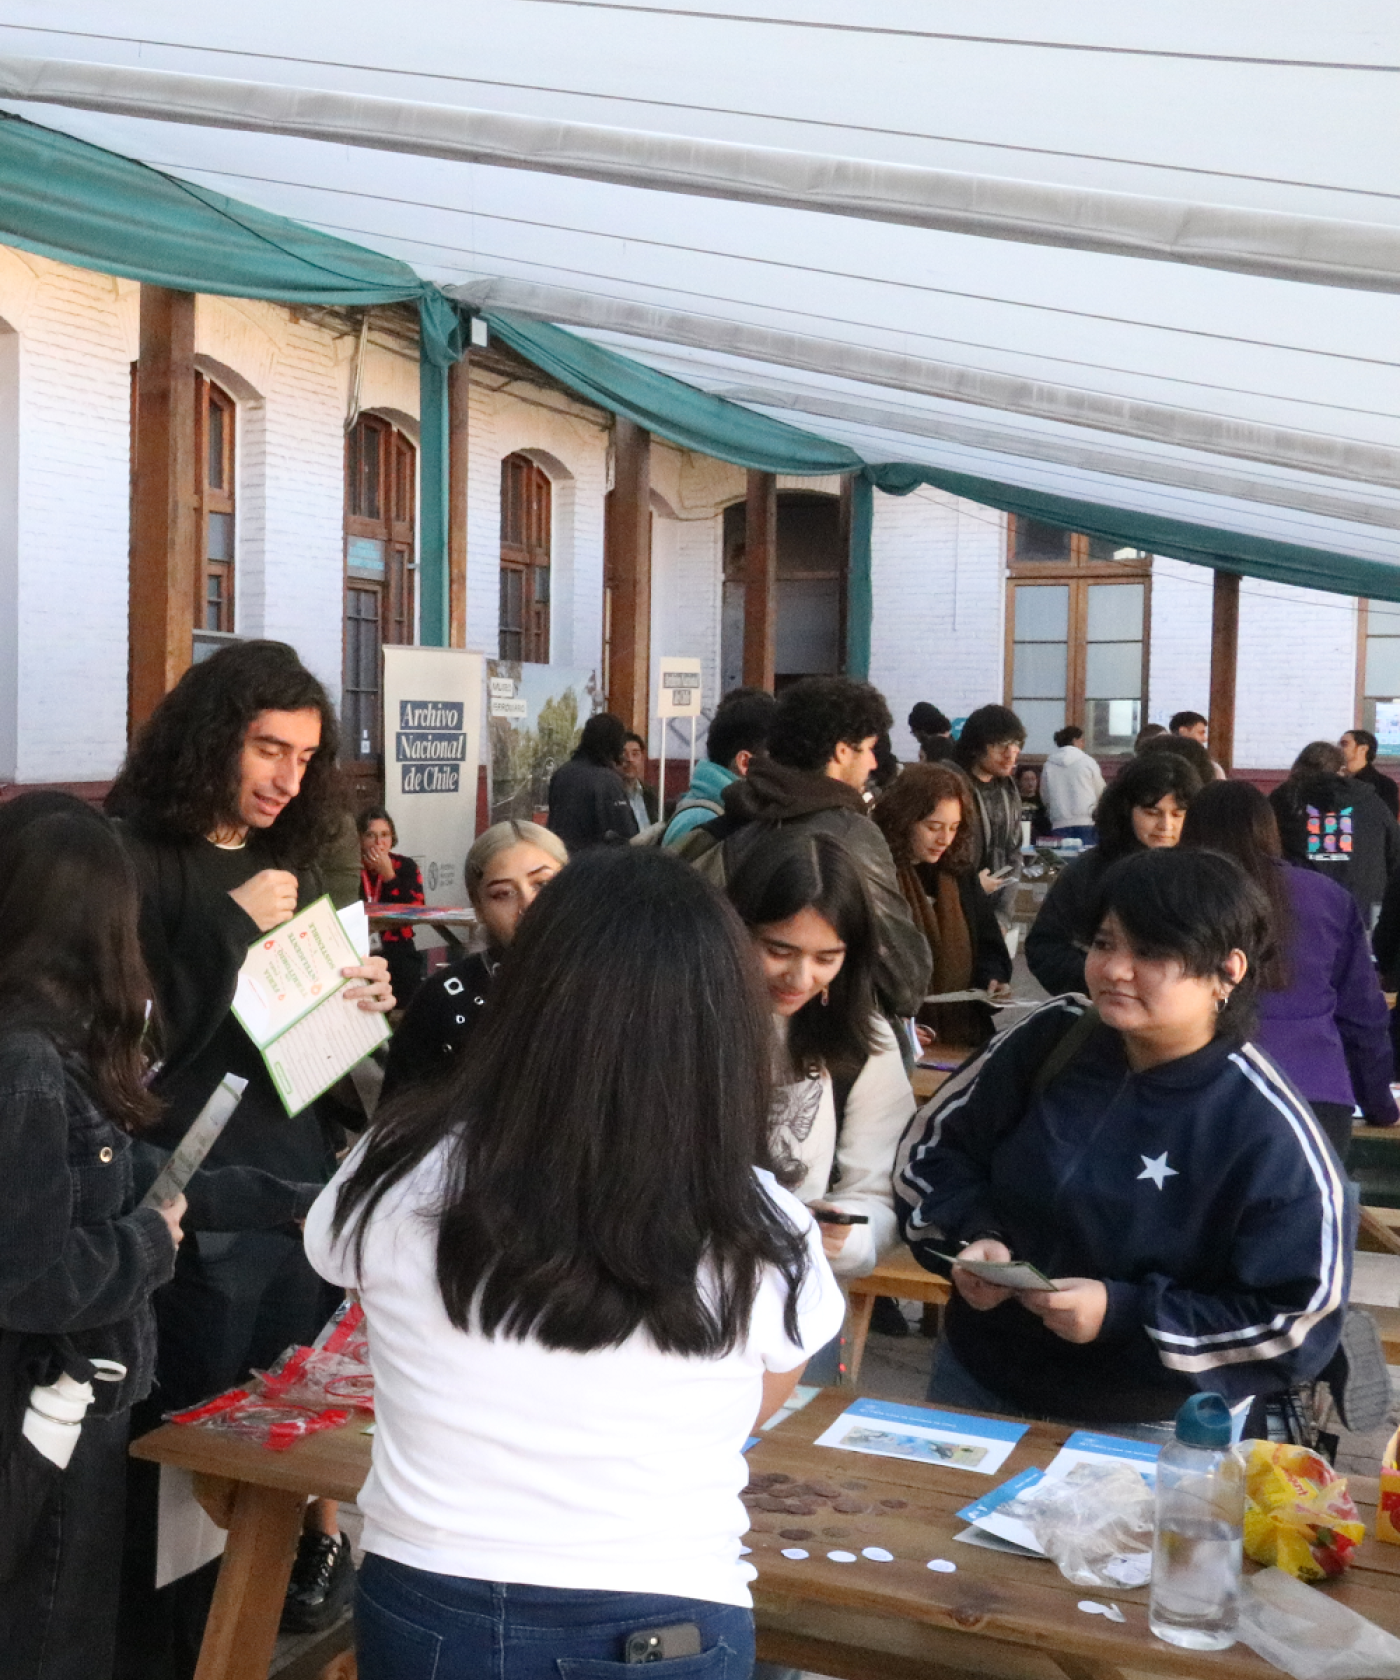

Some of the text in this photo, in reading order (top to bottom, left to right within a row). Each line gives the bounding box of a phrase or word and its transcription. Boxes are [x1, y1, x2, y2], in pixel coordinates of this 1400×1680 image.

[401, 702, 459, 728] Archivo
[399, 734, 464, 759] Nacional
[404, 765, 458, 791] de Chile
